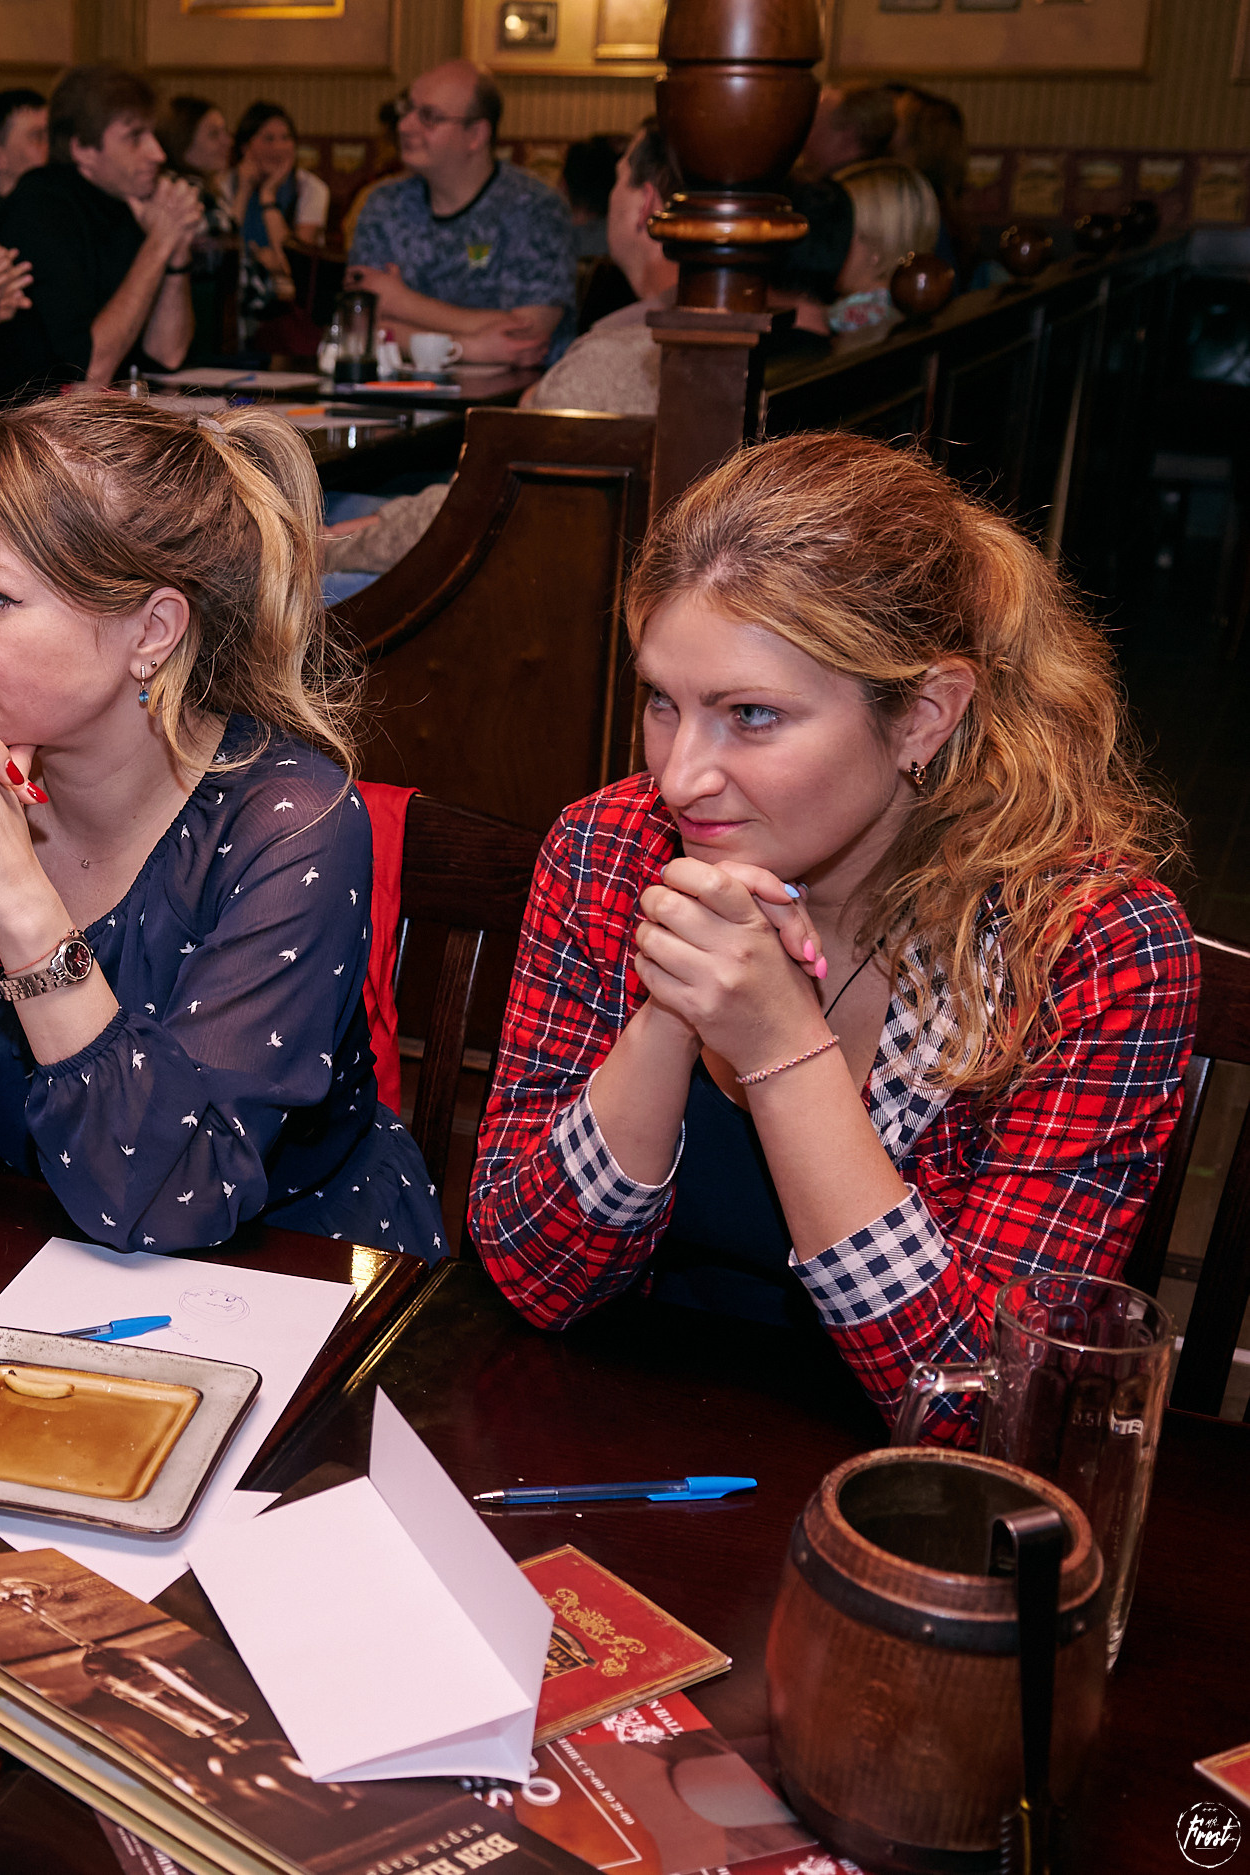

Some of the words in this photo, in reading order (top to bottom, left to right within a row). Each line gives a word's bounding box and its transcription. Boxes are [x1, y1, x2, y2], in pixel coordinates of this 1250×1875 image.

[653, 1709, 684, 1736] HALL
[581, 1768, 605, 1790] 17-00
[610, 1802, 635, 1825] 21-00
[426, 1822, 485, 1854] карта
[454, 1832, 519, 1870] BEN
